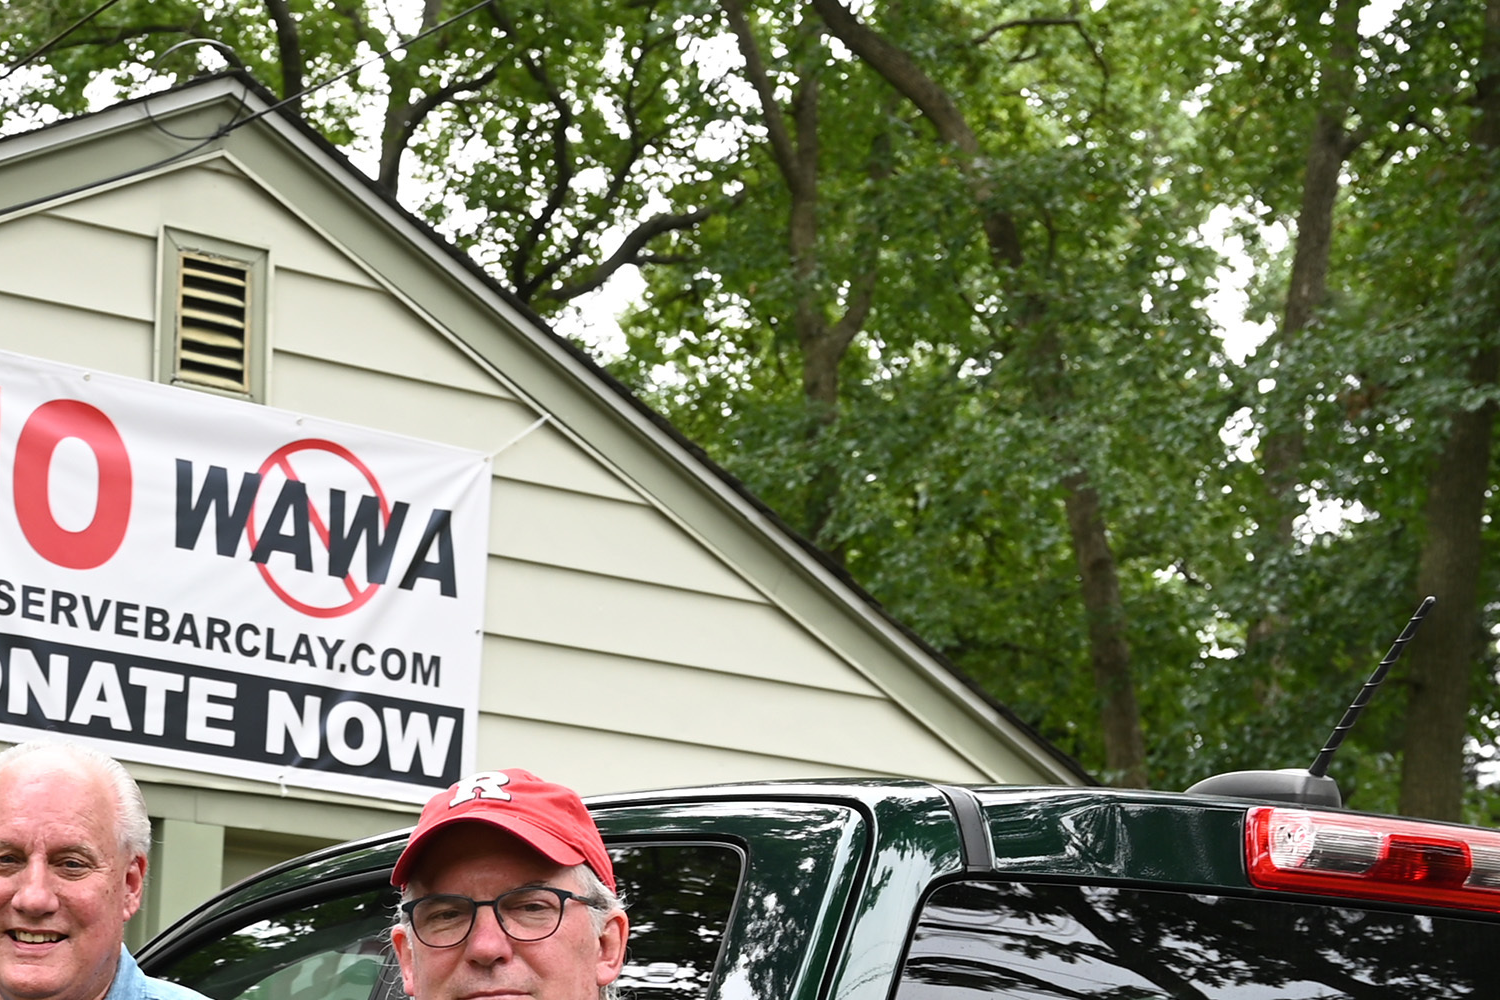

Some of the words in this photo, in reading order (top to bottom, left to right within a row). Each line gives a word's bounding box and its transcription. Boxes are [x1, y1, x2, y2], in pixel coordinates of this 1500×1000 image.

[175, 458, 459, 598] WAWA
[265, 690, 456, 778] NOW
[449, 771, 512, 809] R
